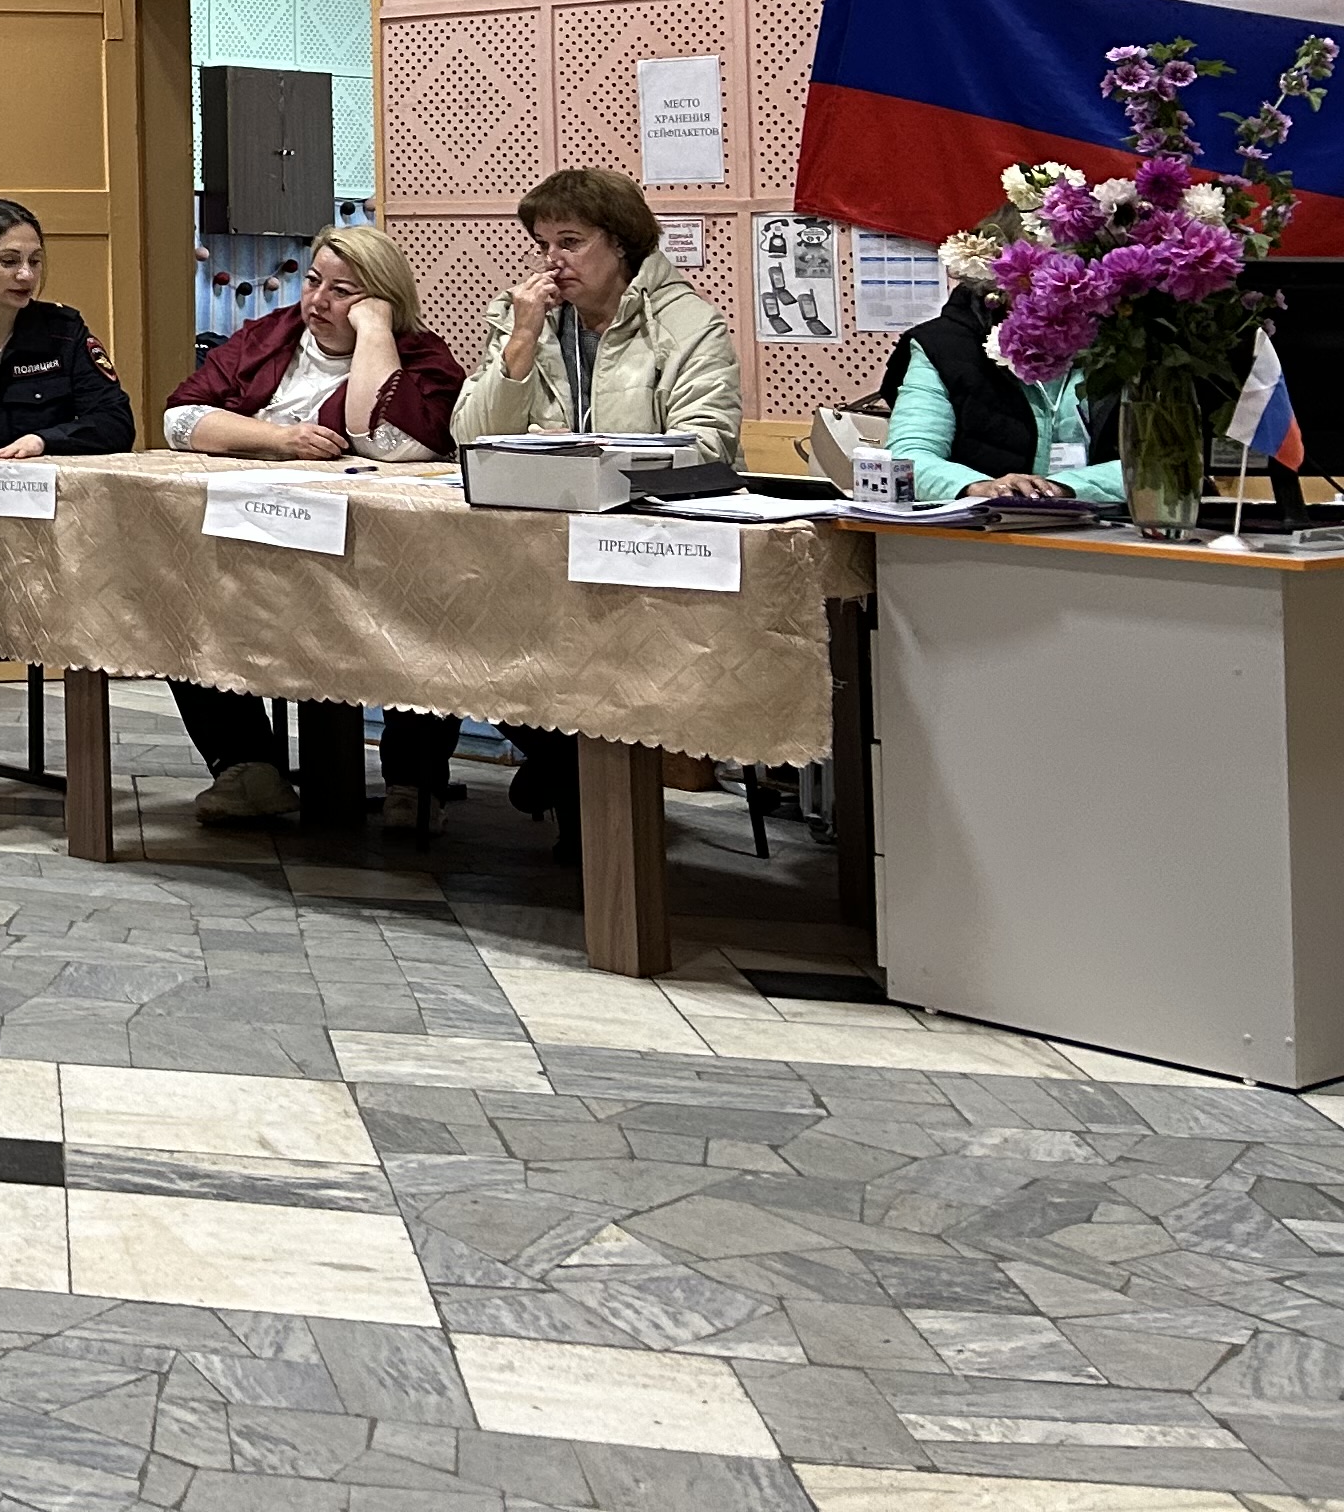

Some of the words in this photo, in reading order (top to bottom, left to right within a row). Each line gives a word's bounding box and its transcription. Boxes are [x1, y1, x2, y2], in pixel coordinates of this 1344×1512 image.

[663, 98, 701, 109] МЕСТО
[654, 113, 711, 124] ХРАНЕНИЯ
[13, 359, 60, 375] ПОЛИЦИЯ
[244, 500, 312, 521] СЕКРЕТАРЬ
[598, 539, 712, 558] ПРЕДСЕДАТЕЛЬ
